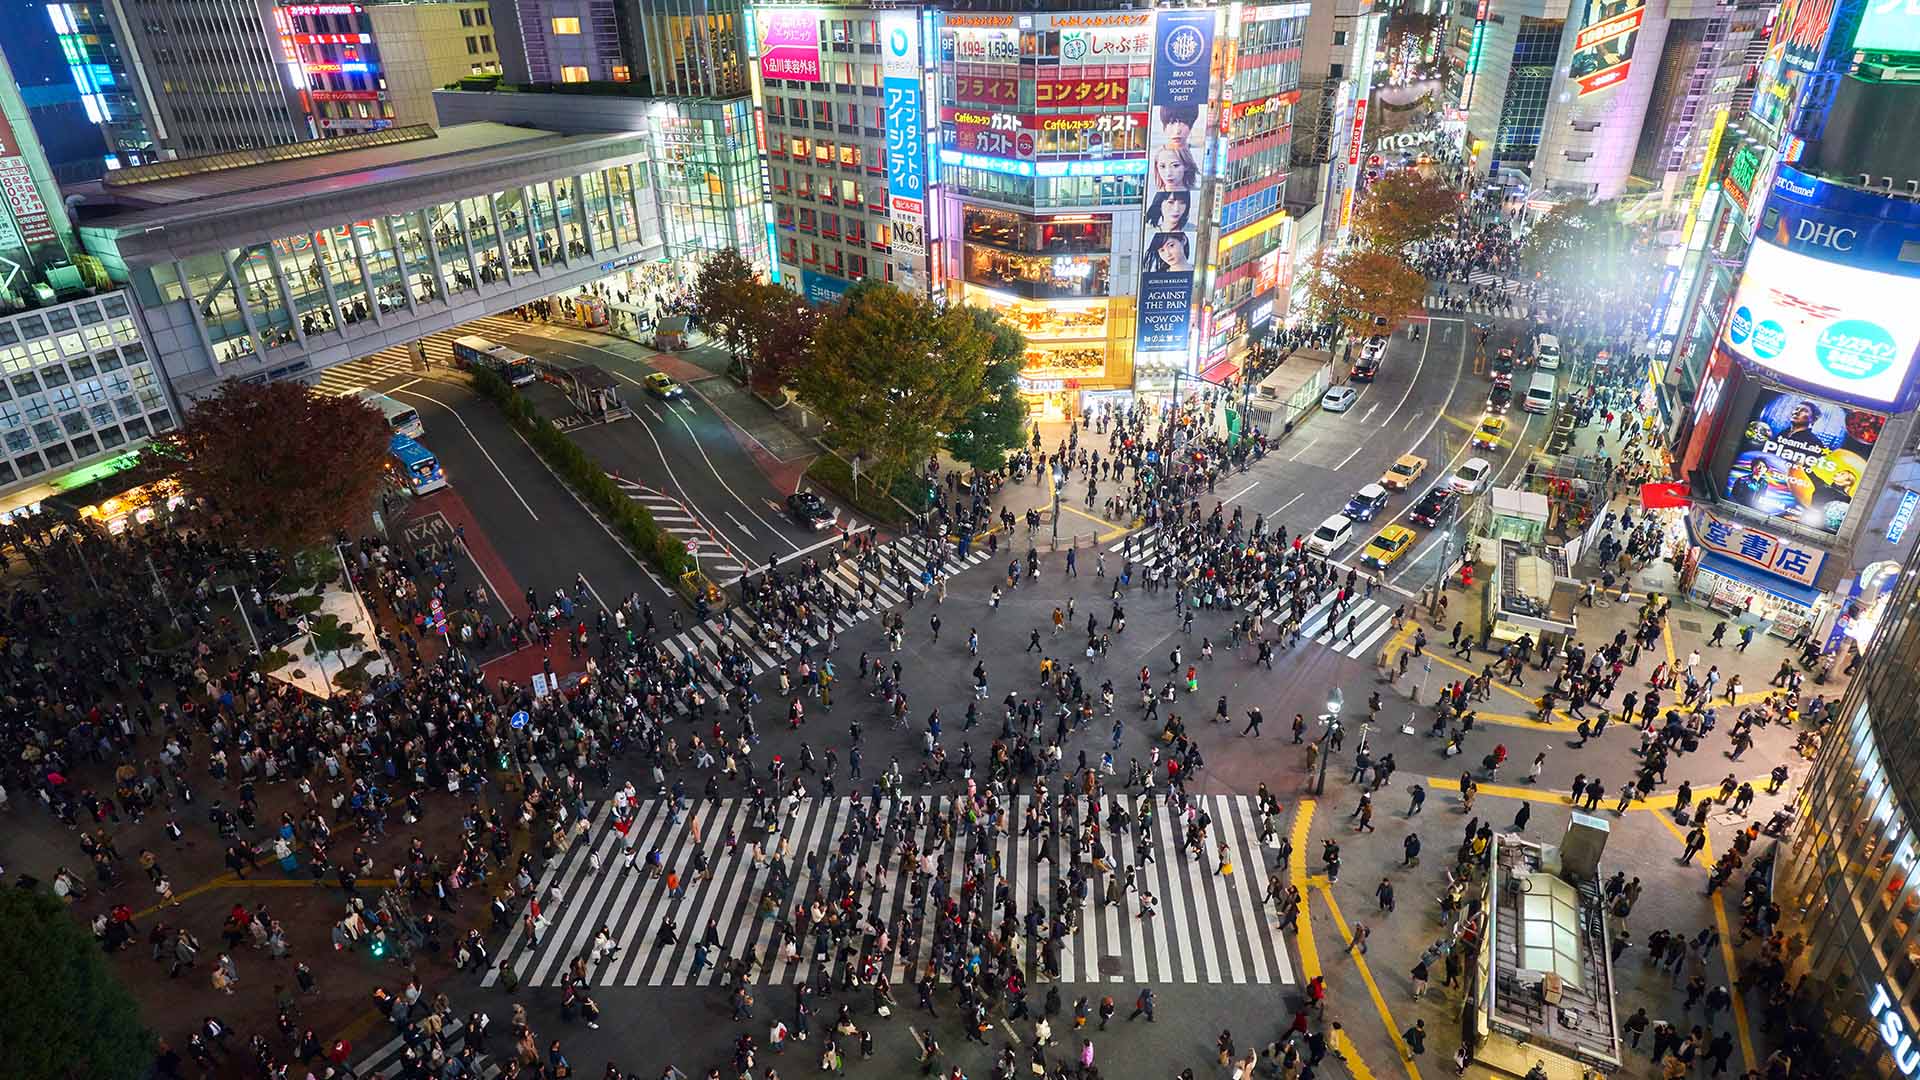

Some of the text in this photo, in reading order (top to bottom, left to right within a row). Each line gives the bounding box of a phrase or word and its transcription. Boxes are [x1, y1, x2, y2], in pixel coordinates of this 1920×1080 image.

[942, 39, 954, 50] 9F
[1092, 33, 1149, 54] しゃぶ葉
[768, 58, 817, 75] 品川美容外科
[1037, 82, 1125, 100] コンタクト
[991, 113, 1022, 131] ガスト
[1096, 115, 1138, 131] ガスト
[888, 88, 905, 188] アイシティ
[905, 89, 919, 190] コンタクトの
[976, 131, 1013, 154] ガスト
[1786, 180, 1815, 198] Channel
[892, 222, 923, 246] No.1
[1795, 219, 1857, 251] DHC
[1145, 300, 1187, 309] THE PAIN
[1148, 291, 1187, 300] AGAINST
[1145, 314, 1185, 324] NOW ON
[1154, 323, 1174, 331] SALE
[1777, 436, 1821, 455] teamLab
[1763, 440, 1838, 472] Planets
